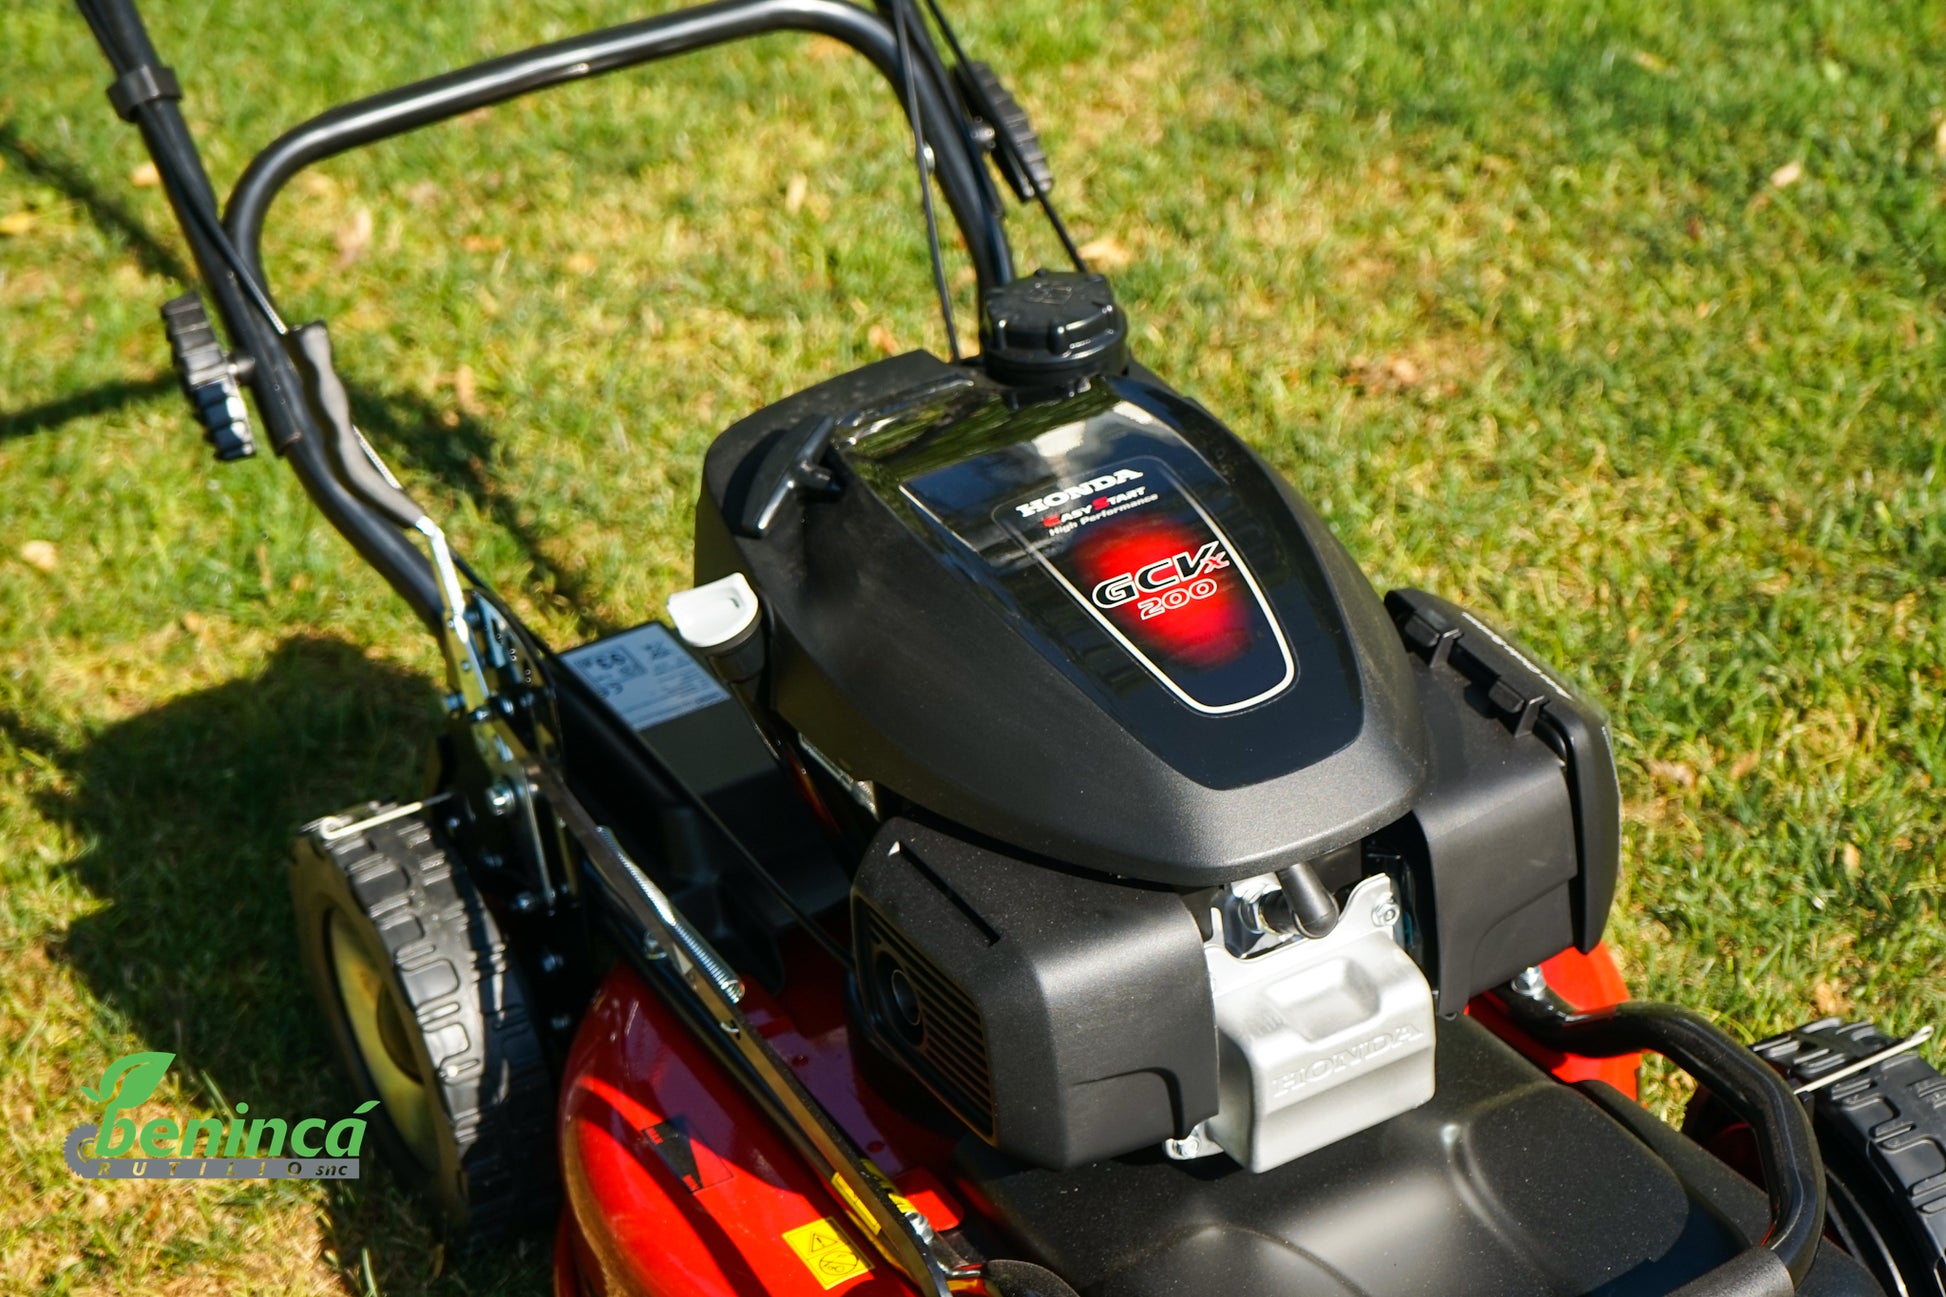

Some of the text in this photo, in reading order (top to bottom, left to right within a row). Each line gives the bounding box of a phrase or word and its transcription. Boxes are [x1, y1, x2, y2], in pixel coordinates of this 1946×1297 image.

[1016, 468, 1143, 517] HONDA
[1049, 493, 1158, 537] High Performance
[1138, 578, 1217, 620] 200
[1272, 1024, 1424, 1098] HONDA
